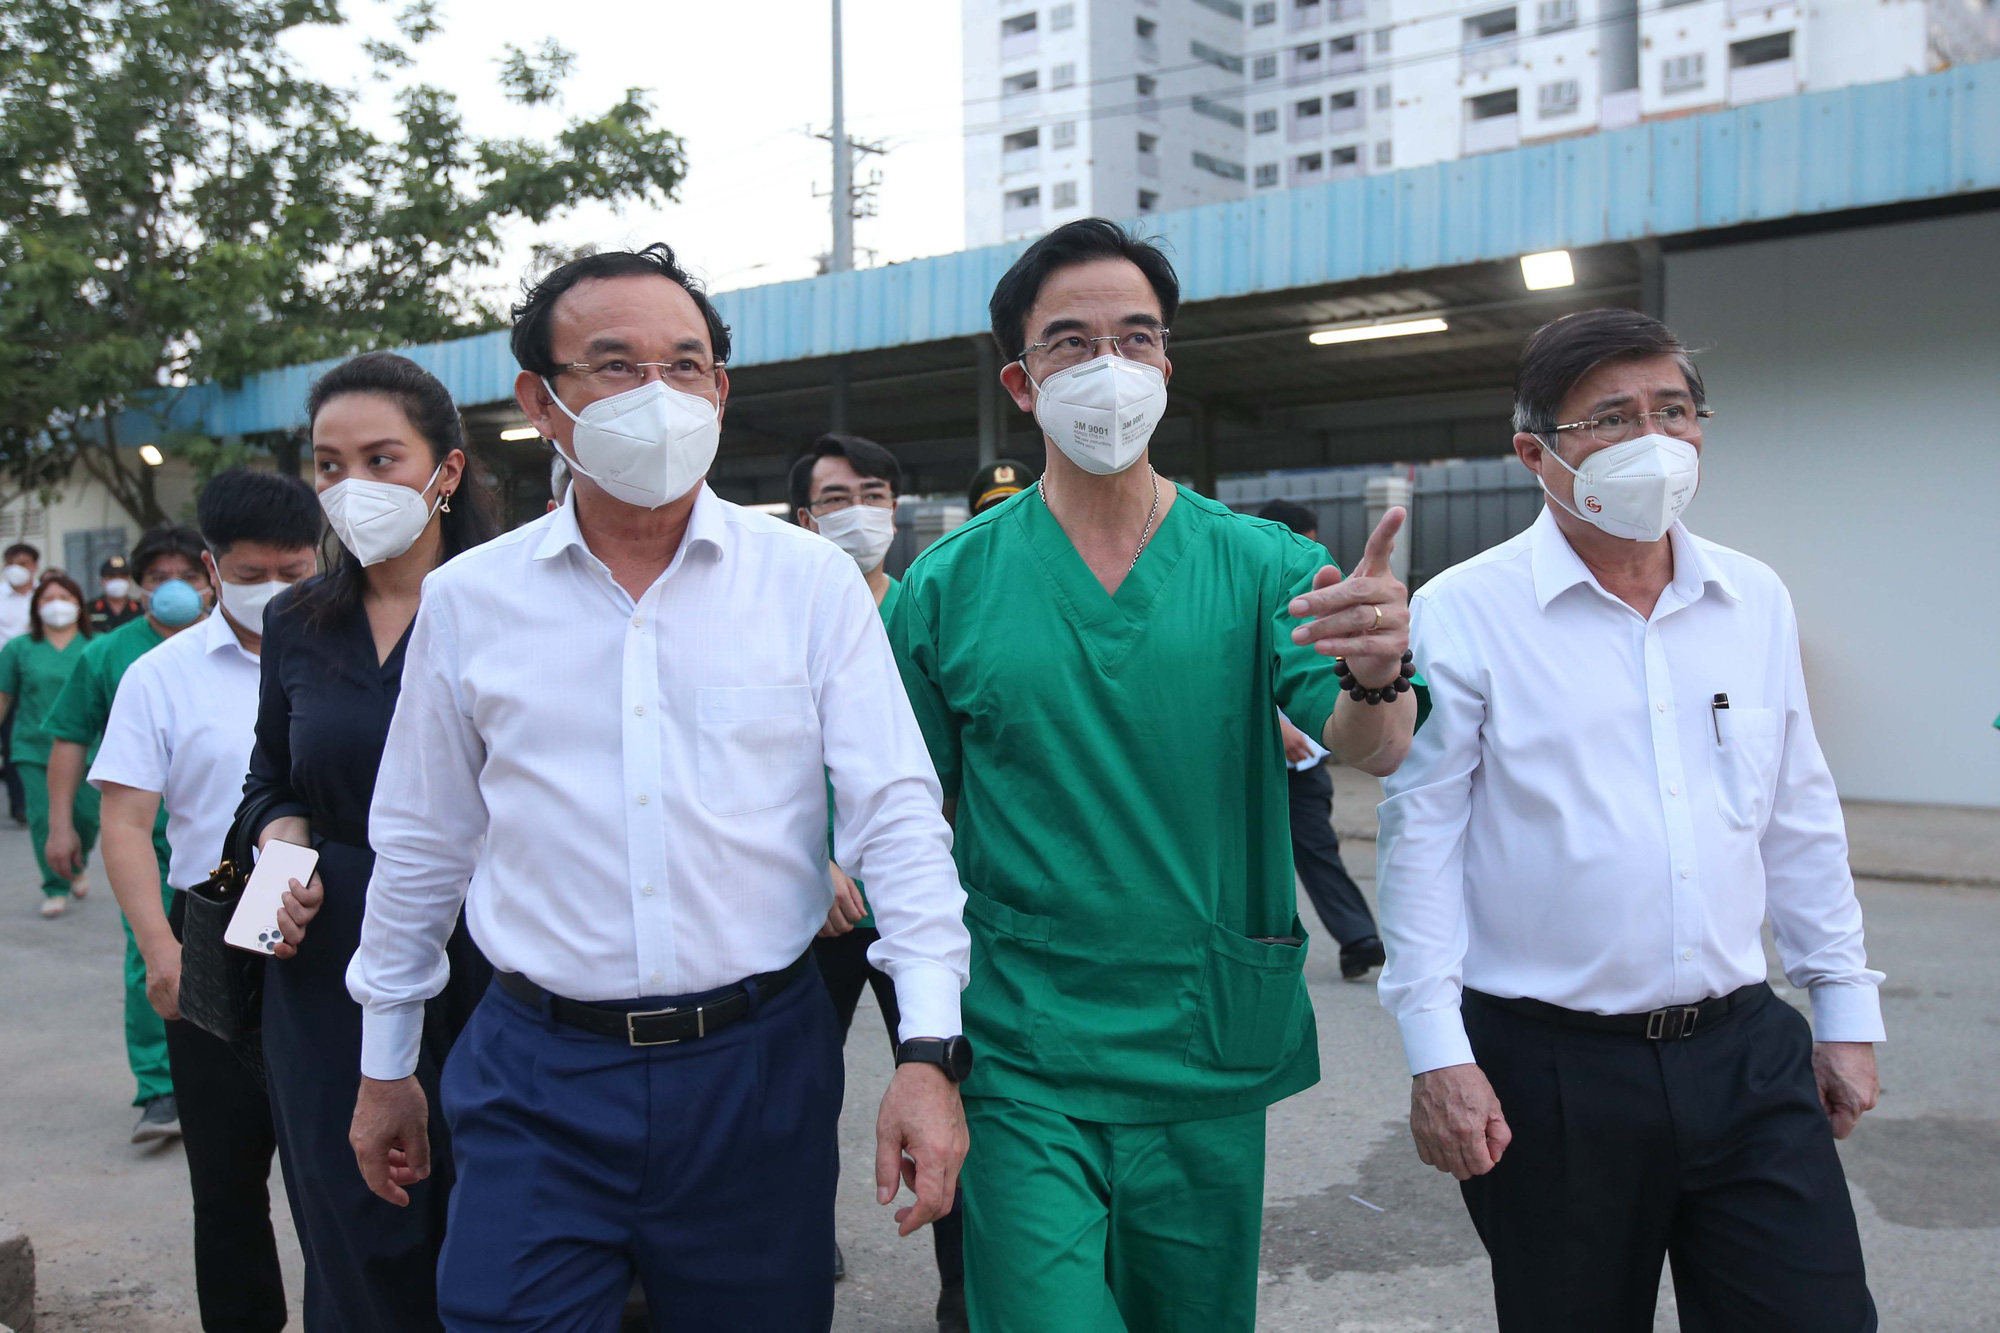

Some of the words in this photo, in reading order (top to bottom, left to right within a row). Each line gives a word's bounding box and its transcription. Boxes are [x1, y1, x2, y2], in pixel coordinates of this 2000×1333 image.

[1073, 420, 1086, 431] 3M
[1088, 424, 1109, 436] 9001
[1123, 420, 1132, 430] 3M
